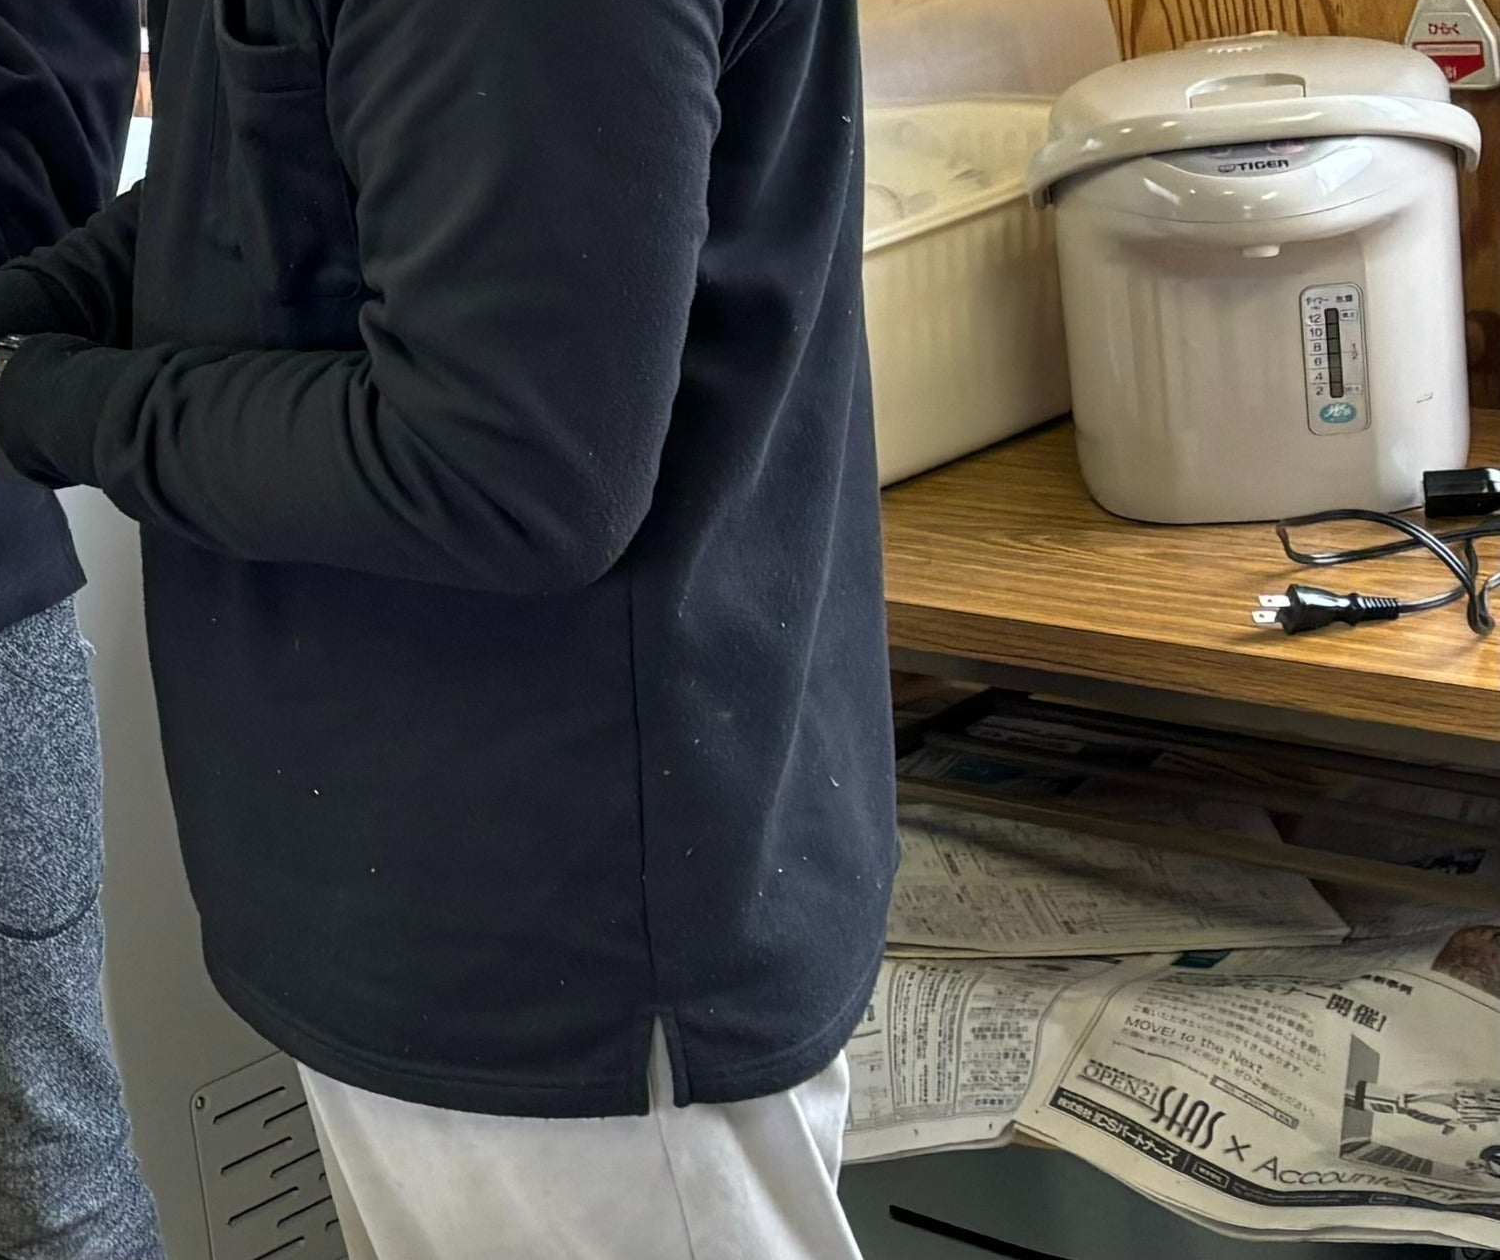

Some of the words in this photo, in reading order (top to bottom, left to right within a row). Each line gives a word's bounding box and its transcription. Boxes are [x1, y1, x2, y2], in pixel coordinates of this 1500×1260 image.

[1238, 159, 1290, 172] TIGER
[1308, 313, 1322, 324] 12
[1309, 327, 1324, 337] 10
[1313, 342, 1322, 352] 8
[1315, 386, 1324, 396] 2
[1124, 1015, 1177, 1037] MOVE!
[1180, 1030, 1196, 1043] to
[1200, 1037, 1225, 1056] the
